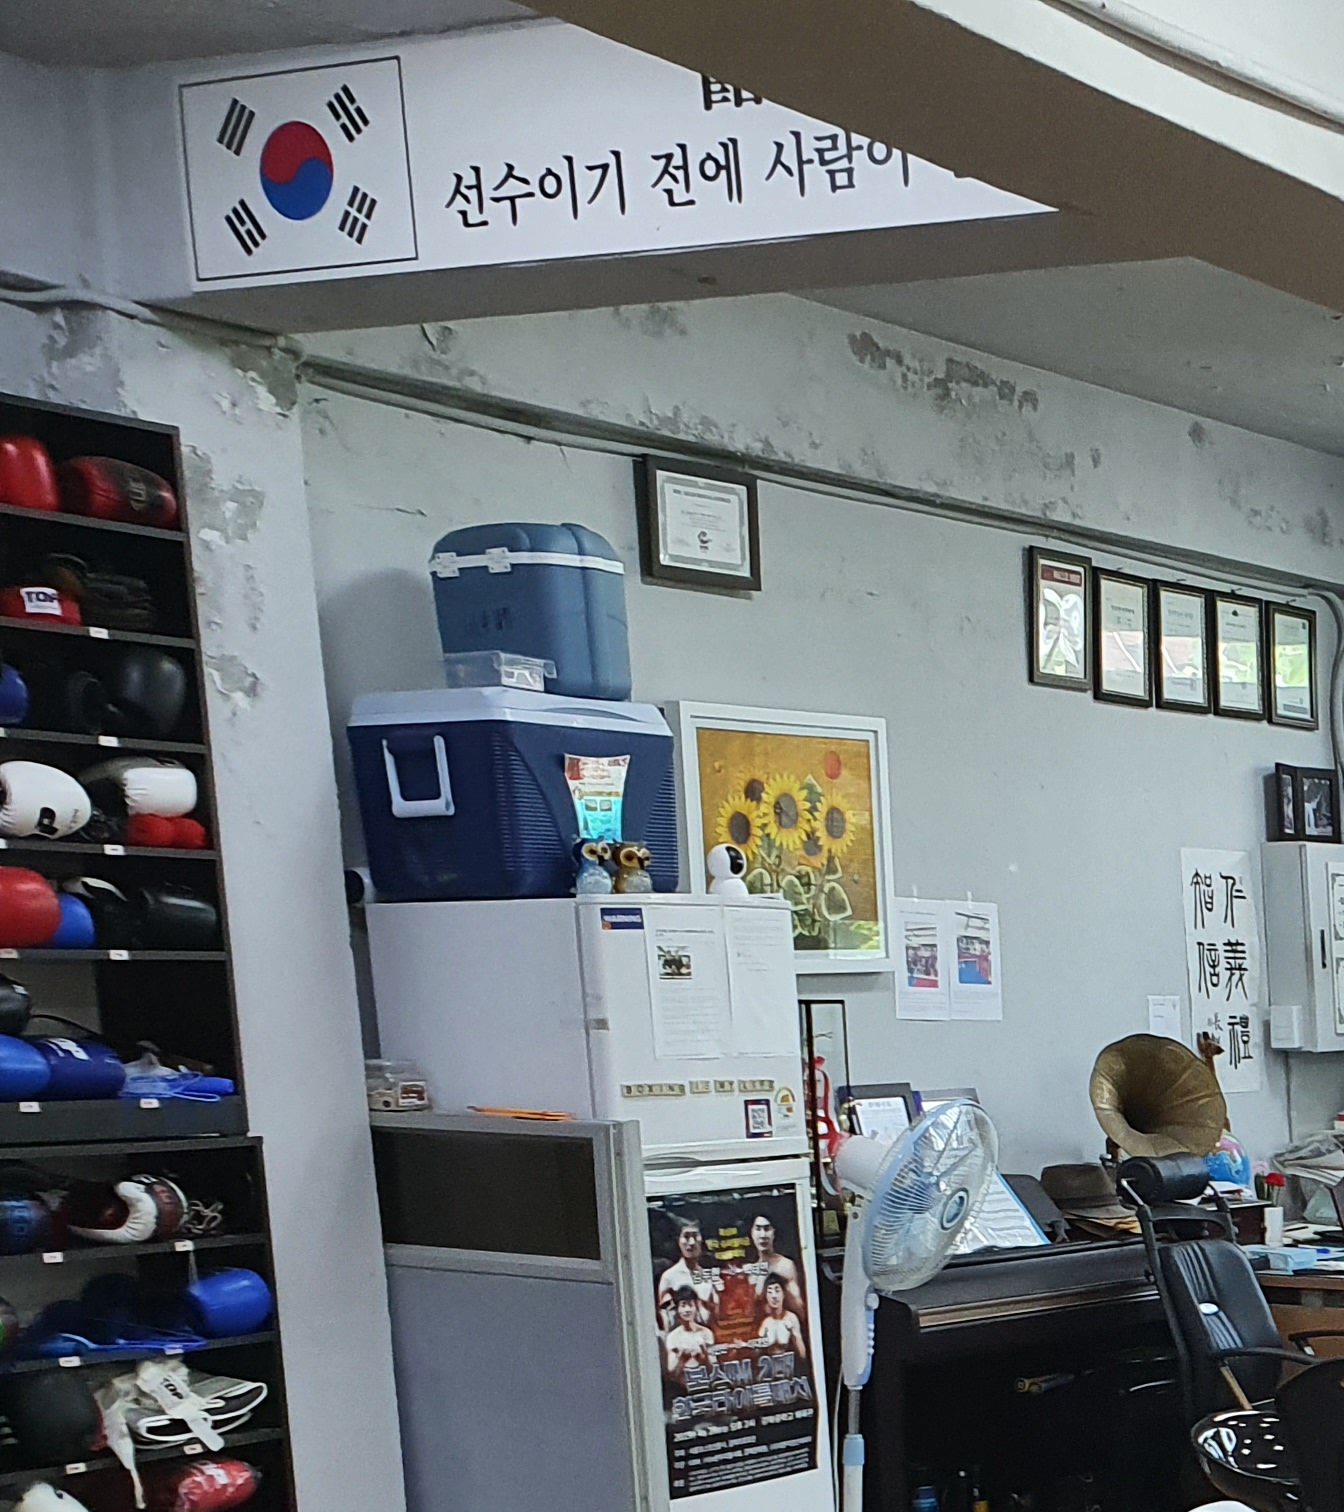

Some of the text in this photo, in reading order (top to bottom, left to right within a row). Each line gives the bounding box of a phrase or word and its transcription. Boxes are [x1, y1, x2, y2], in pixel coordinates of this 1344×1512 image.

[444, 129, 911, 229] 선수이기 전에 사람이
